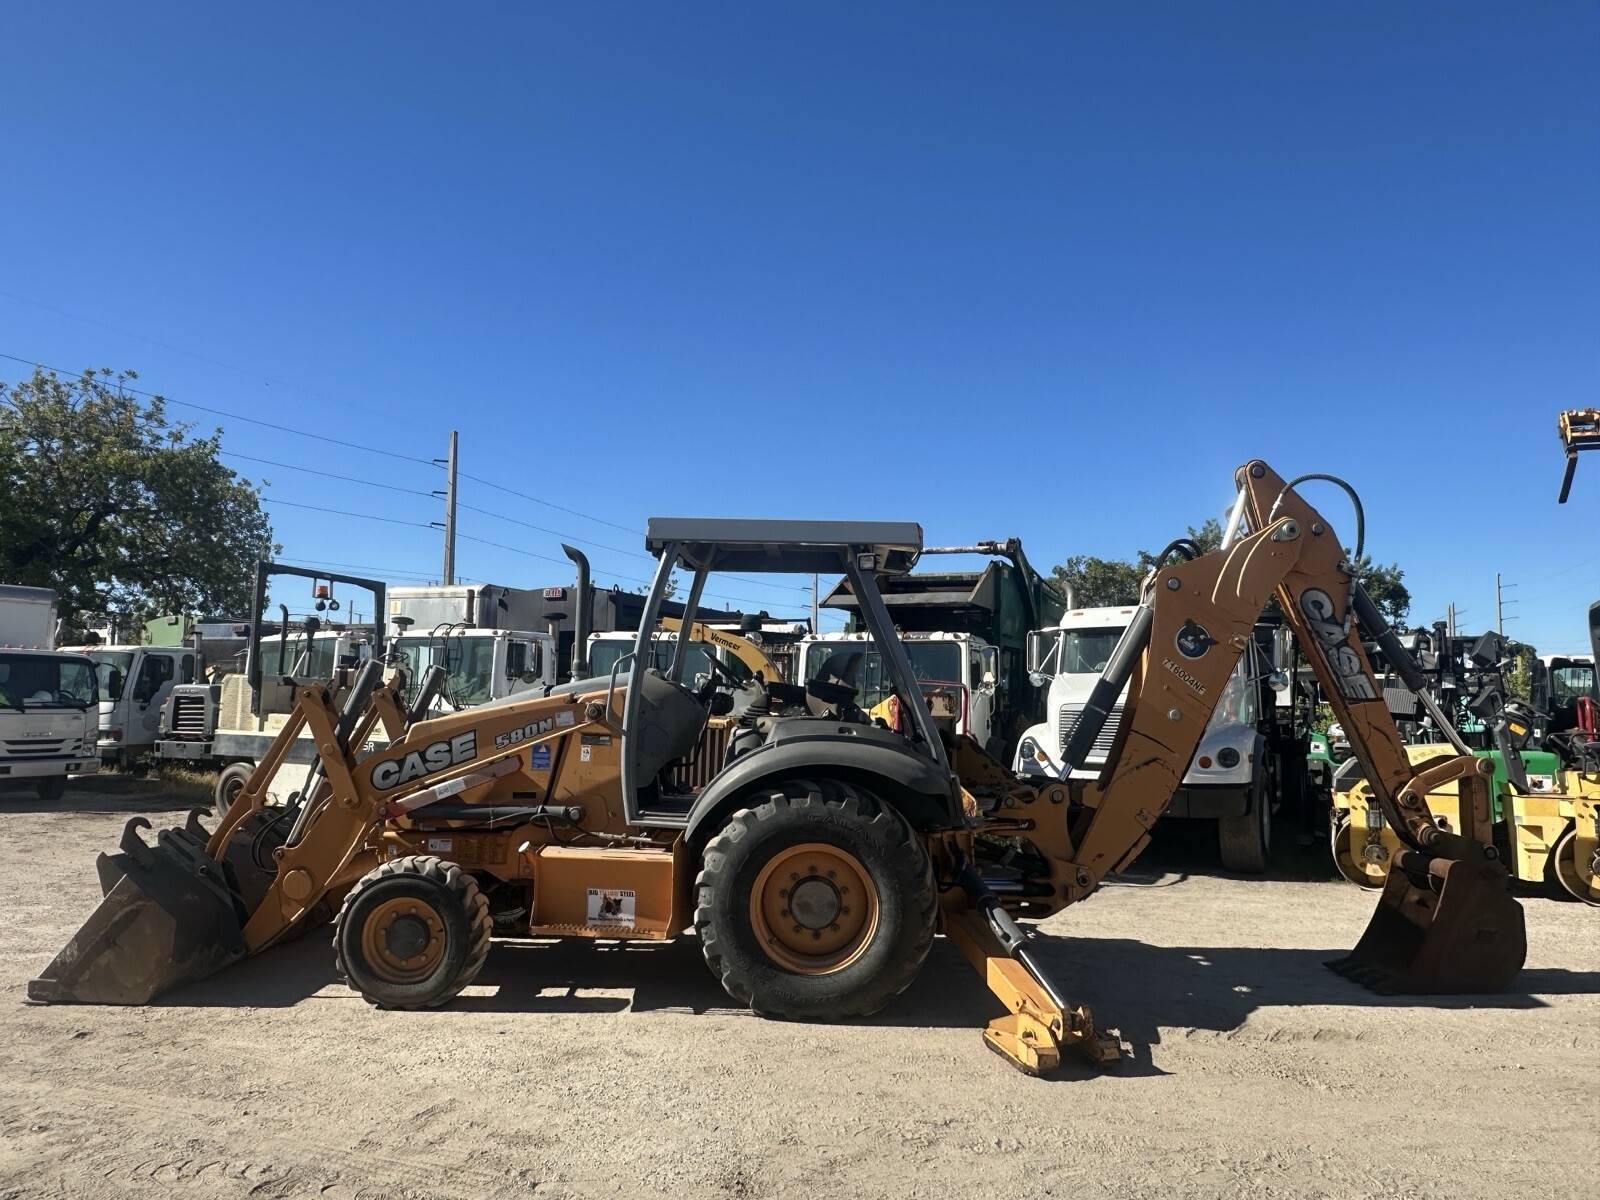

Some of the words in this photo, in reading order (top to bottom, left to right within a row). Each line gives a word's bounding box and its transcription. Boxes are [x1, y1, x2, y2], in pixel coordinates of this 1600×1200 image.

[711, 632, 741, 650] Vermeer
[1300, 588, 1379, 701] CASE
[1163, 658, 1206, 693] 716004NF
[495, 718, 553, 749] 580N
[371, 730, 476, 790] CASE
